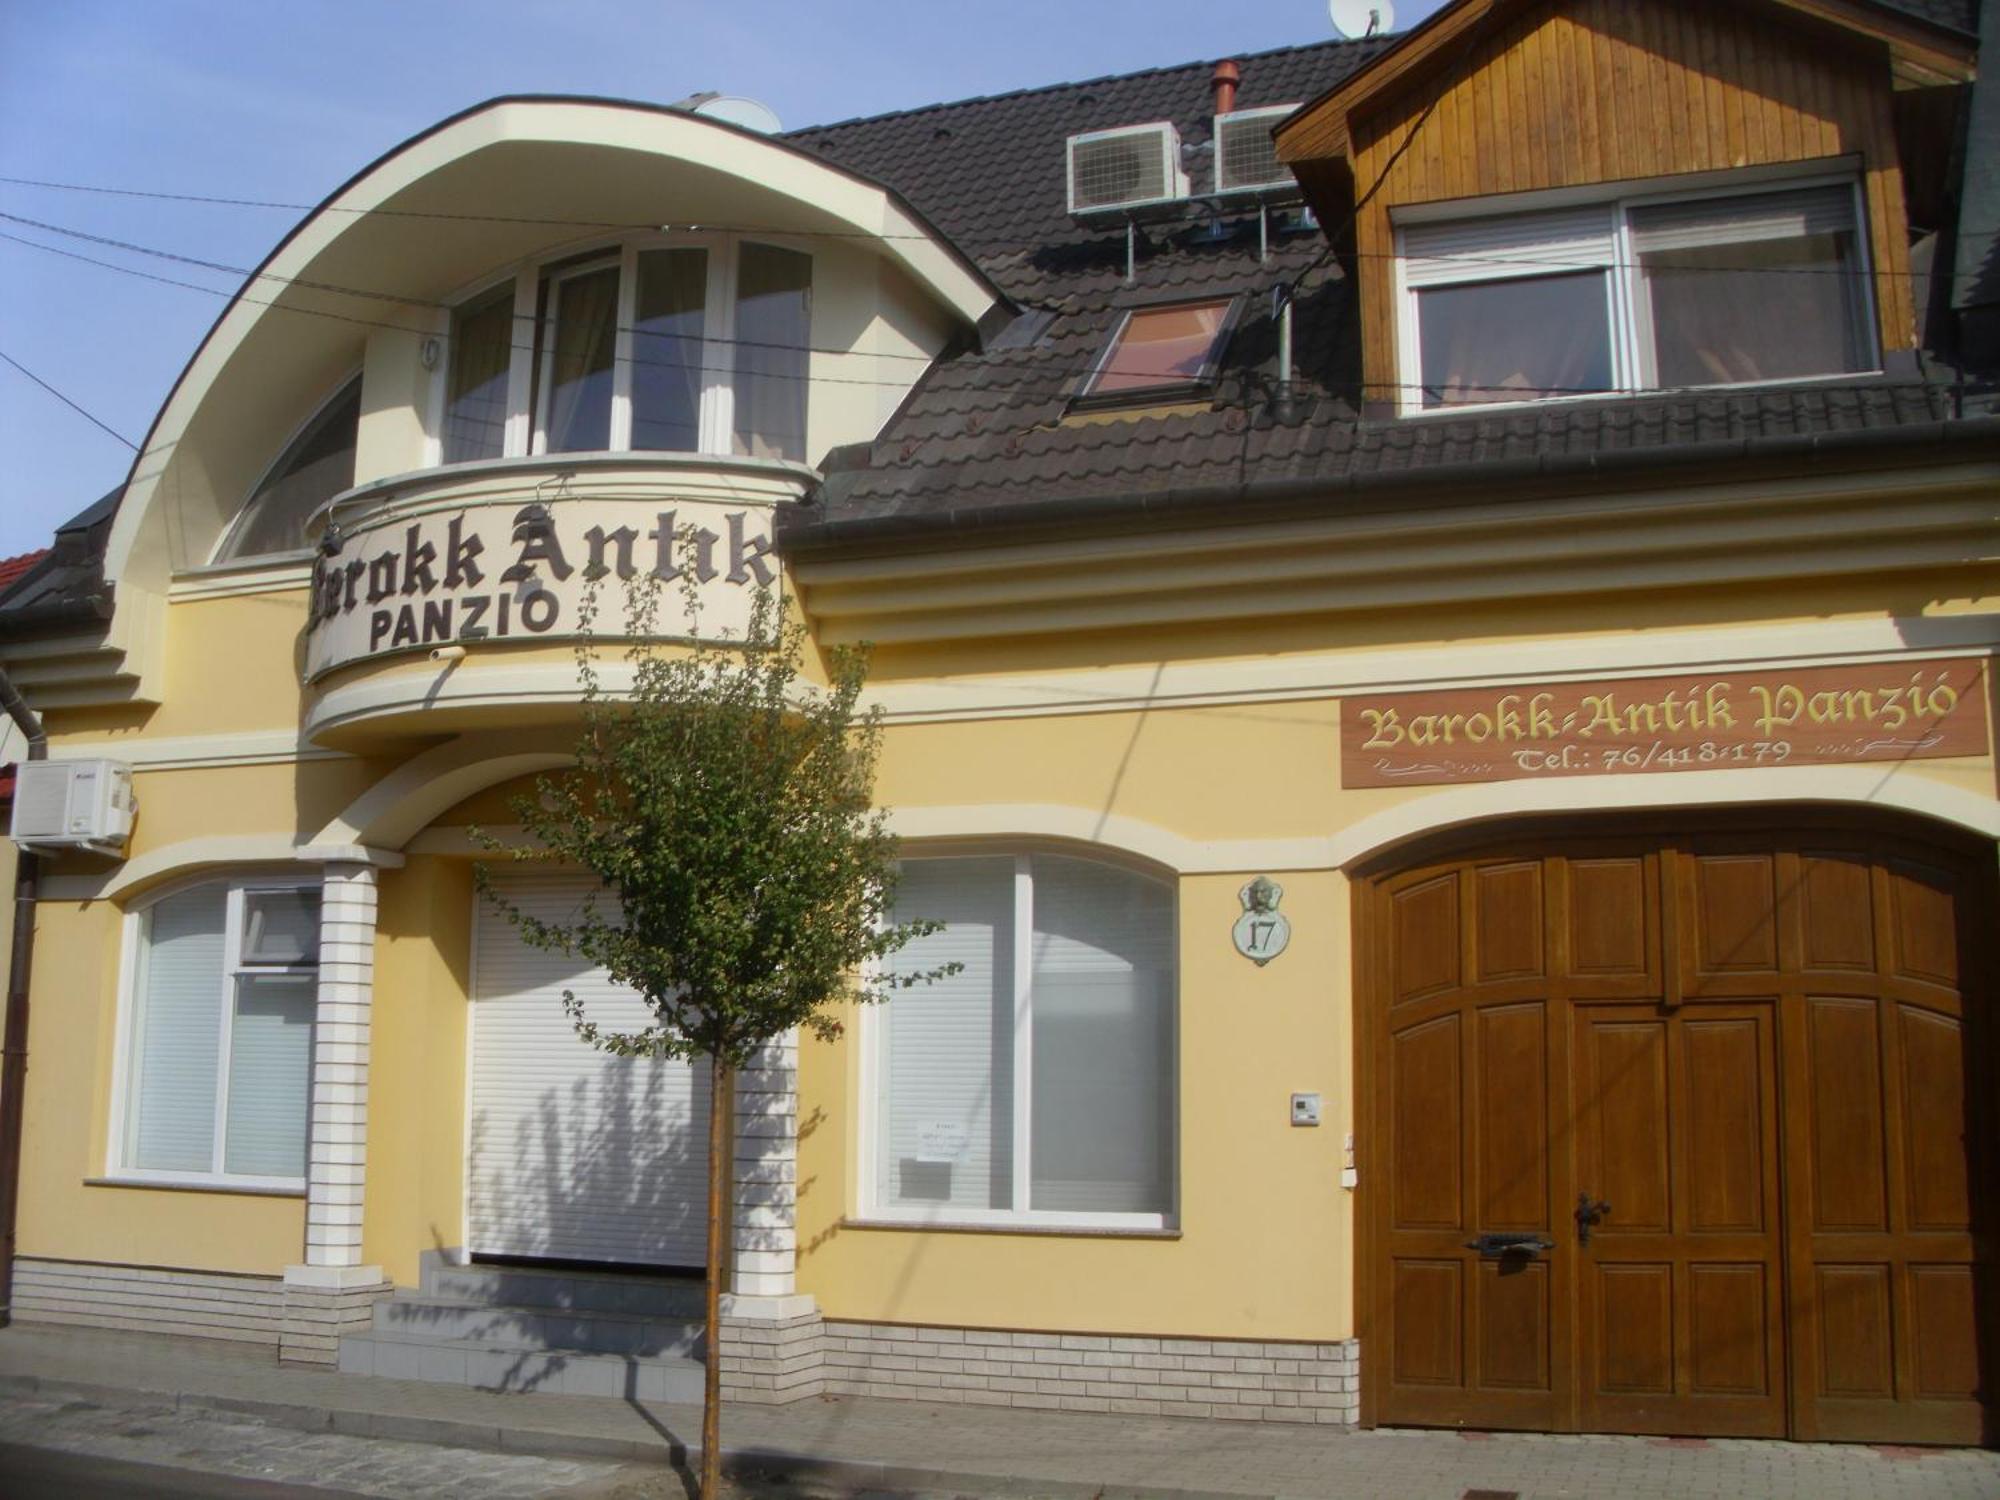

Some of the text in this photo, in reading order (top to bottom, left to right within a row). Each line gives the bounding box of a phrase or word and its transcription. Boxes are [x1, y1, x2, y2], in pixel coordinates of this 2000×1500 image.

[499, 503, 777, 587] Antik
[1749, 671, 1958, 737] Panzió
[1512, 744, 1591, 770] Tel.:
[1247, 920, 1276, 951] 17
